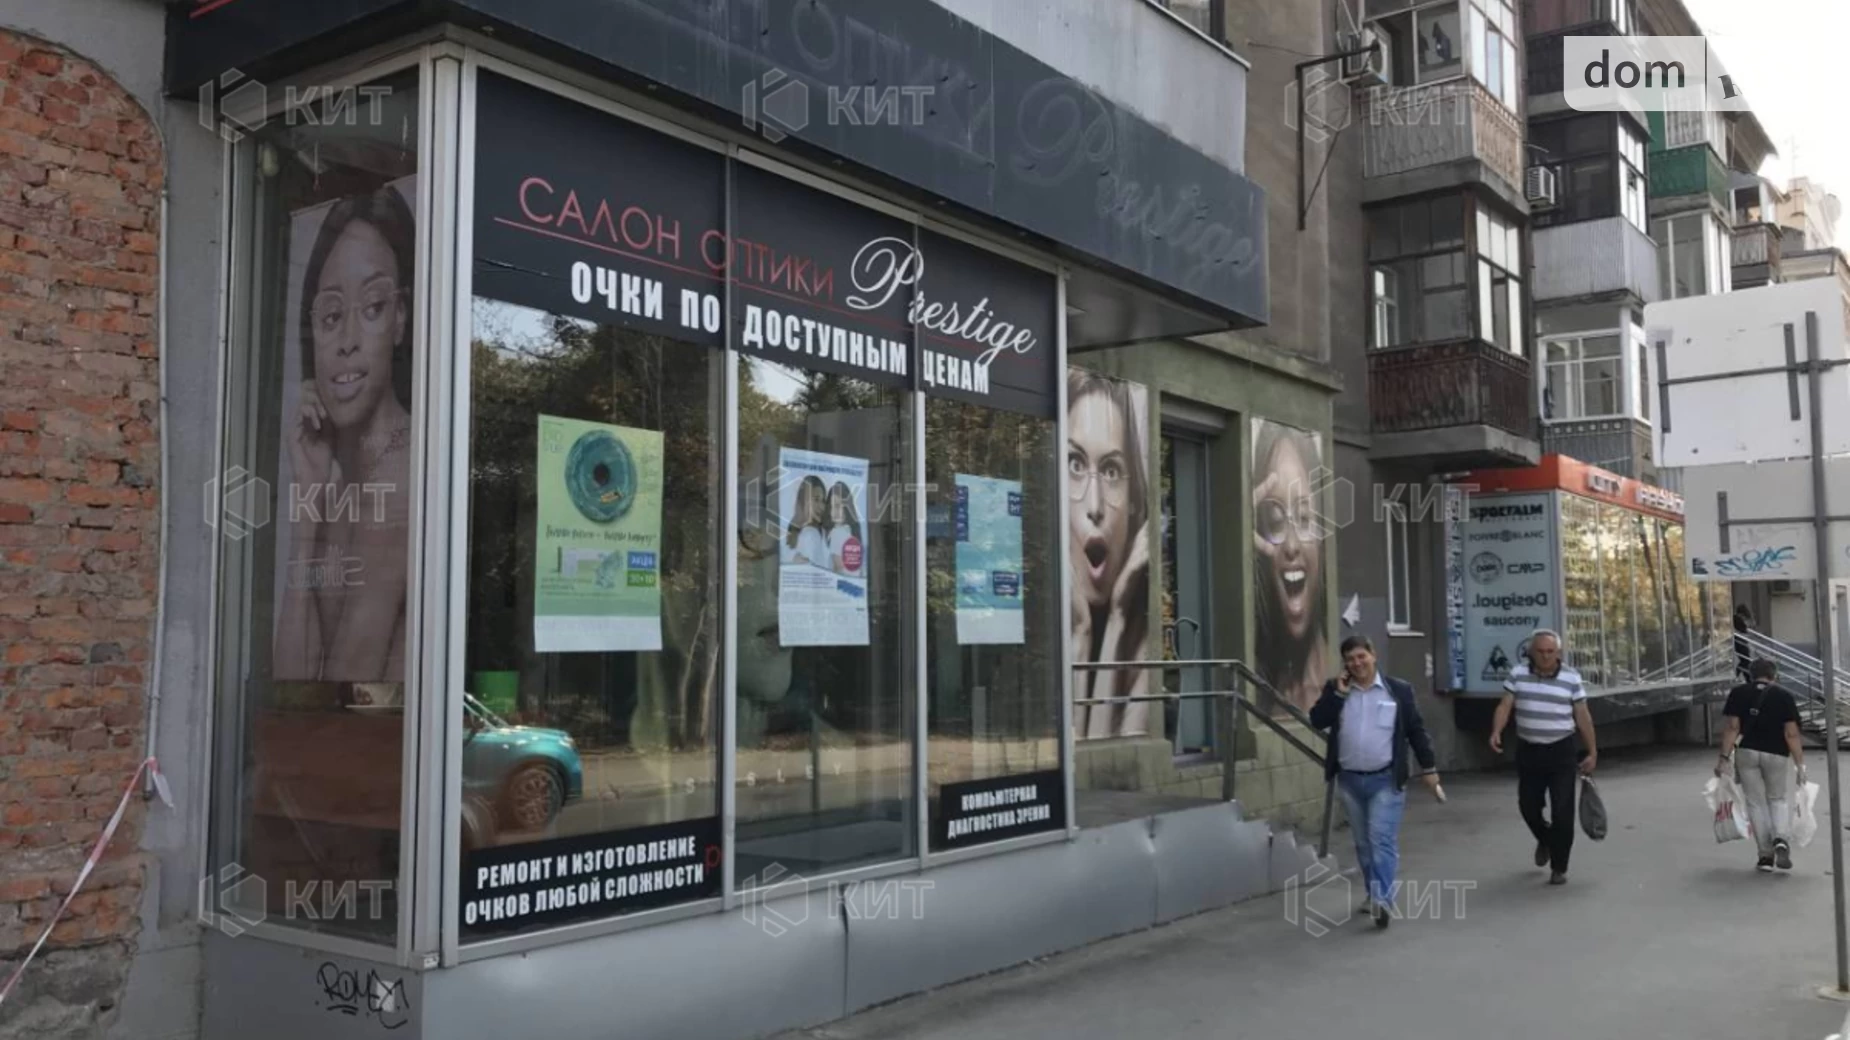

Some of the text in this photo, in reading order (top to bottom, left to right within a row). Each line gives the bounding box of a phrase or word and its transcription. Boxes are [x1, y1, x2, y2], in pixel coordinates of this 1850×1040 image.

[519, 177, 1037, 367] САЛОН ОПТИКИ Prestige
[571, 261, 990, 394] ОЧКИ ПО ДОСТУПНЫМ ЦЕНАМ
[1483, 616, 1539, 628] saucony
[947, 804, 1051, 840] ДИАГНОСТИКА ЗРЕНИЯ
[961, 784, 1037, 811] КОМПЬЮТЕРНАЯ
[477, 836, 696, 889] РЕМОНТ И ИЗГОТОВЛЕНИЕ
[465, 863, 704, 925] ОЧКОВ ЛЮБОЙ СЛОЖНОСТИ
